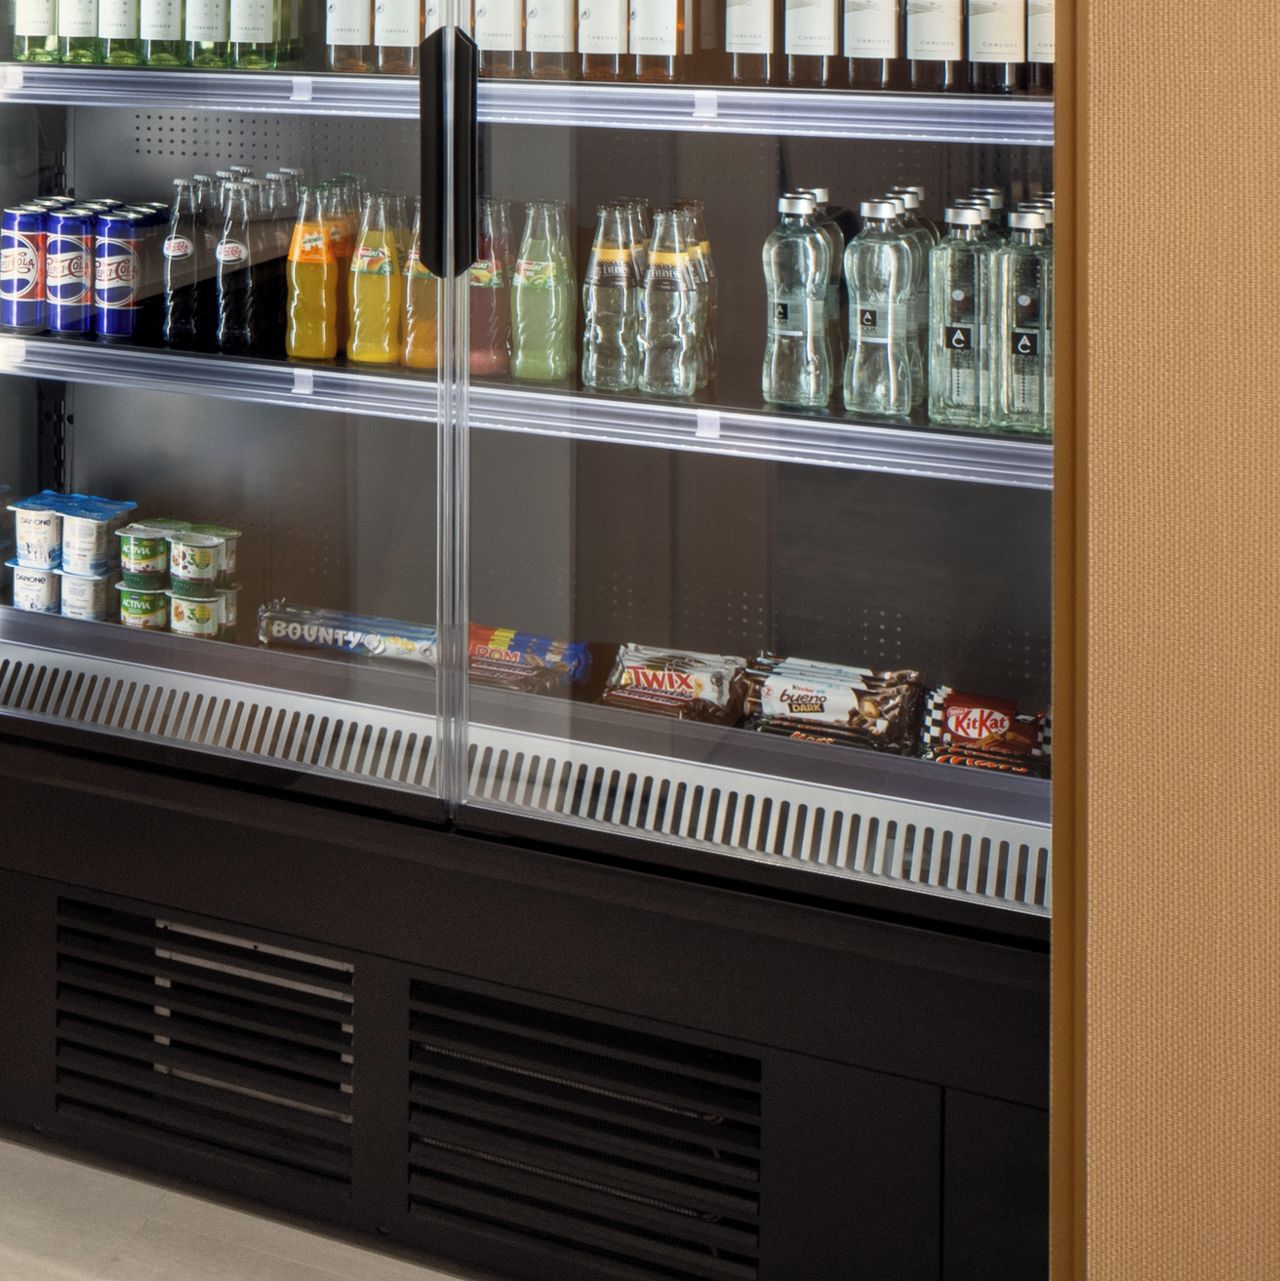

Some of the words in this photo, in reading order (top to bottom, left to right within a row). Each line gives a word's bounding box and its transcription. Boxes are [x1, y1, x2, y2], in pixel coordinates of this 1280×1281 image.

[122, 599, 151, 610] ACTIVIA
[272, 620, 363, 649] BOUNTY
[476, 645, 520, 663] ROM
[624, 664, 696, 691] TWIX
[779, 689, 827, 704] bueno
[791, 703, 822, 713] DARK
[953, 709, 1006, 738] KitKat
